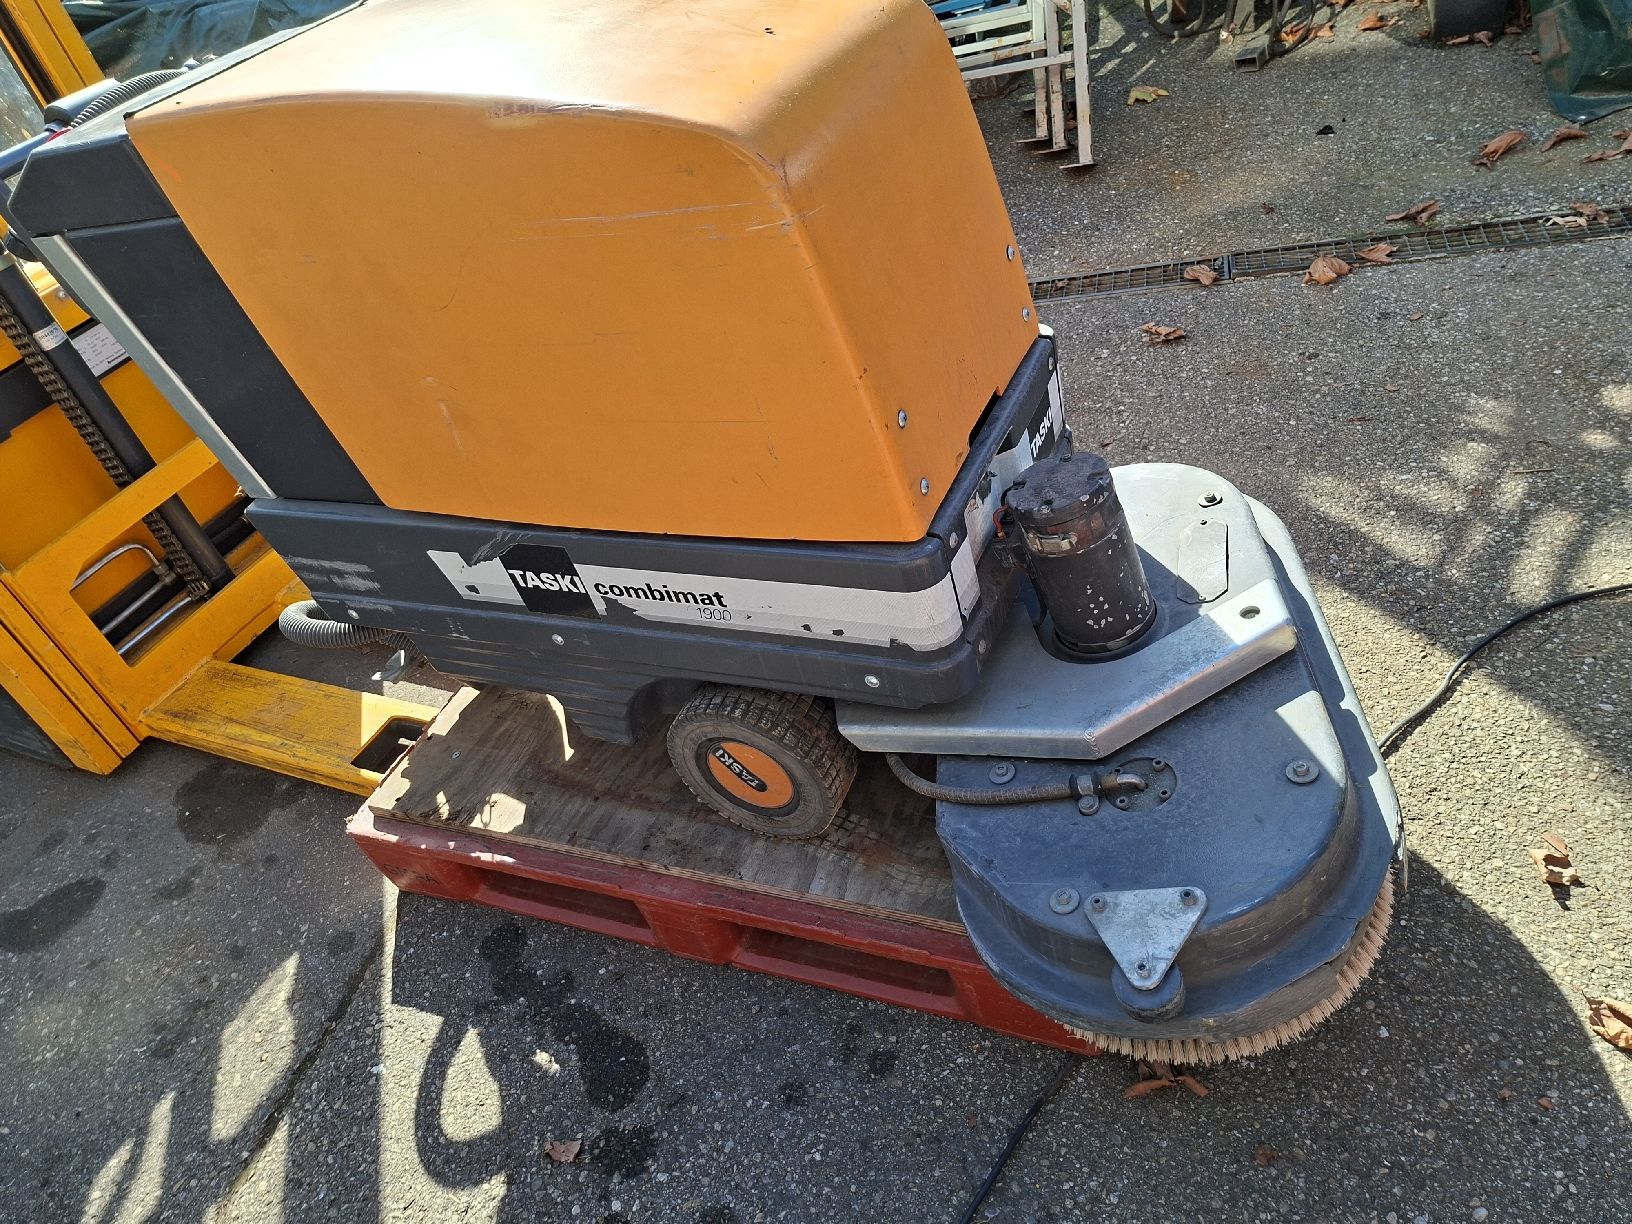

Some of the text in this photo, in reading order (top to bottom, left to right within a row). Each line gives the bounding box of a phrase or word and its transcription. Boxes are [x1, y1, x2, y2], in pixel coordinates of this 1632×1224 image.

[1030, 406, 1052, 458] TASKI
[507, 569, 728, 608] TASKI combimat
[696, 607, 732, 621] 1900
[715, 749, 759, 787] TASKI
